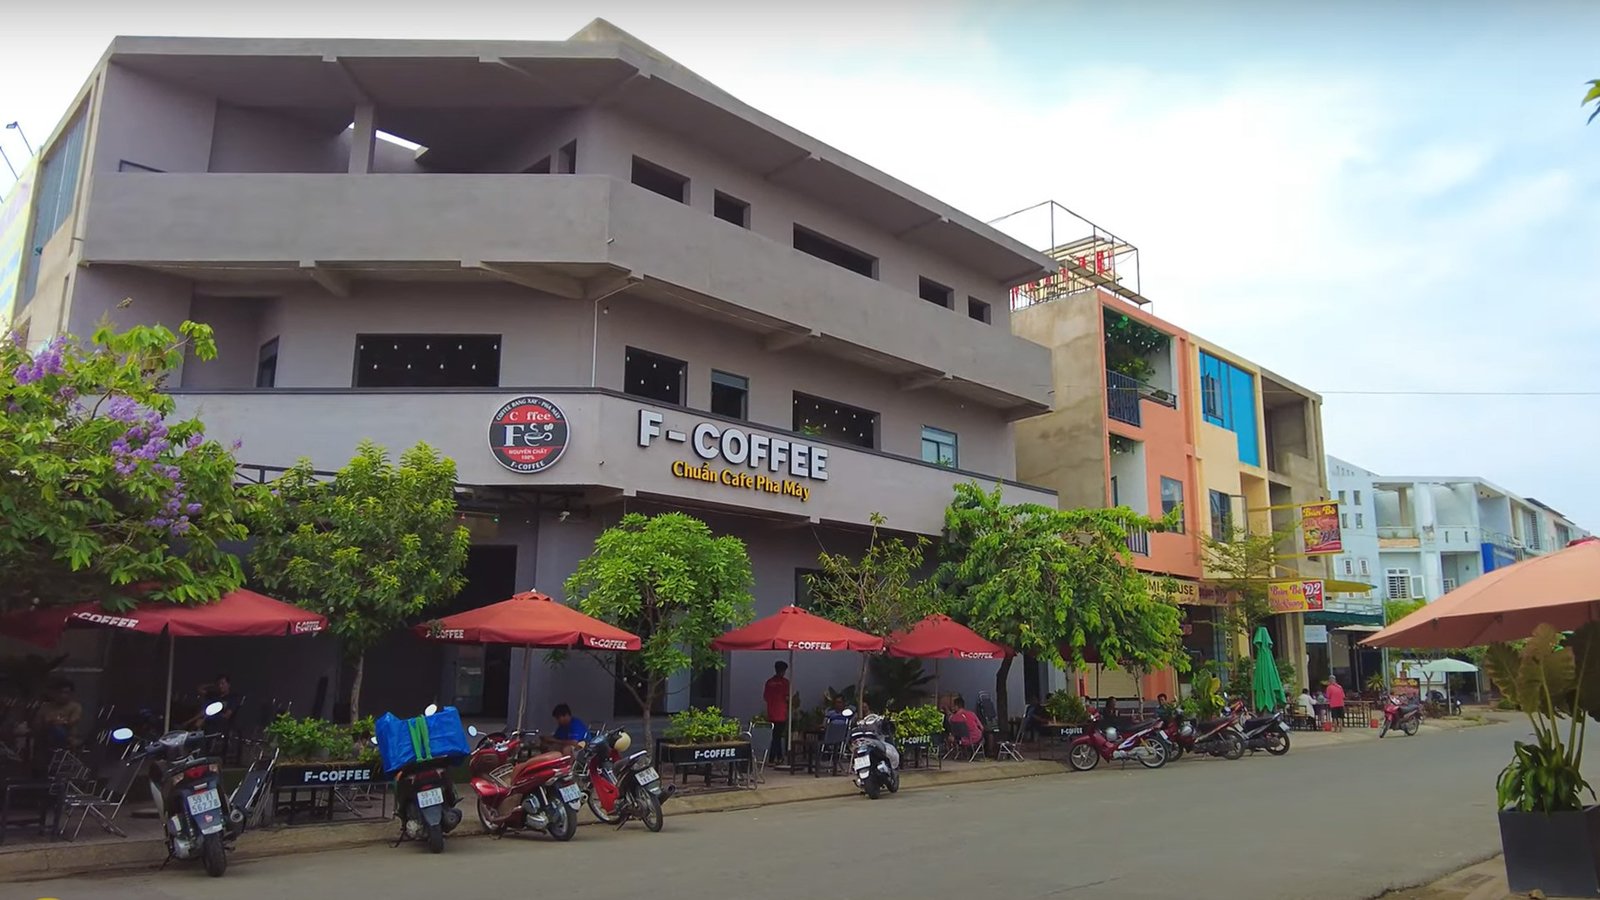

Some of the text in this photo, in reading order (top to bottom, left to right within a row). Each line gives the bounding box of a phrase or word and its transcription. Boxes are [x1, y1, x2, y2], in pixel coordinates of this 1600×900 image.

[721, 469, 753, 488] Cafe
[755, 475, 780, 493] Pha
[65, 611, 139, 628] -COFFEE
[590, 637, 627, 649] F-COFFEE
[788, 641, 831, 650] F-COFFEE
[694, 747, 736, 759] F-COFFEE
[304, 769, 370, 783] F-COFFEE
